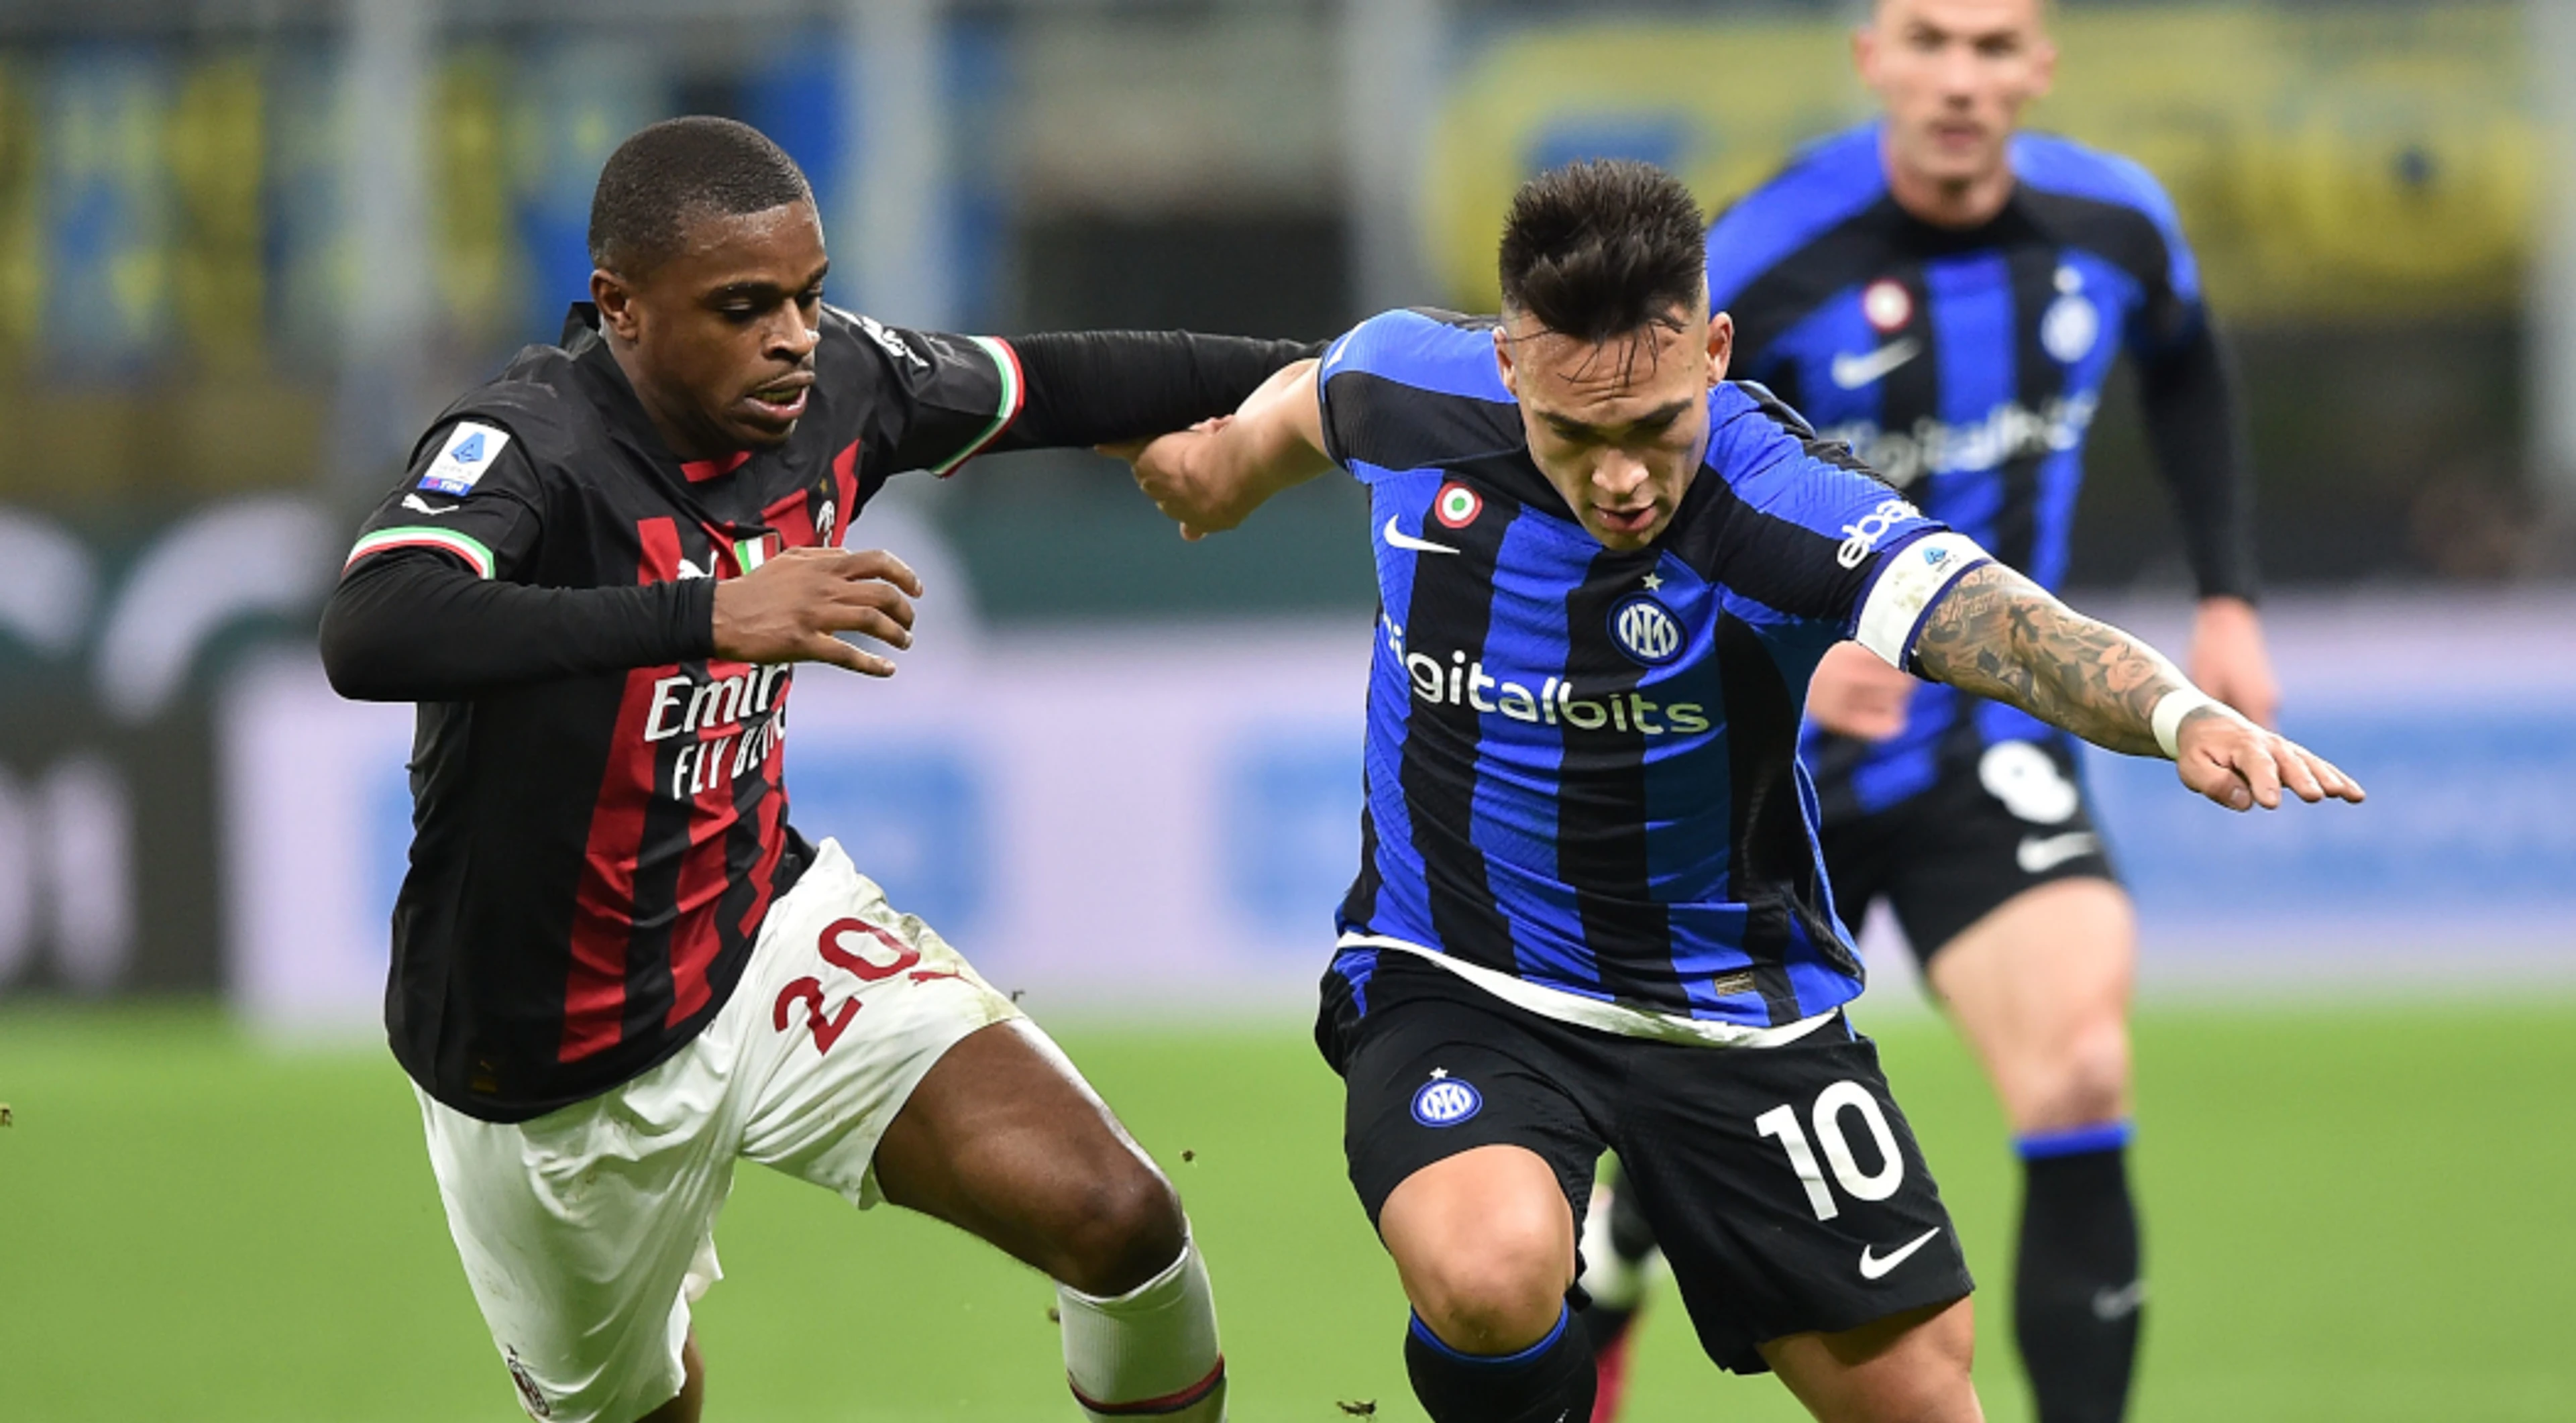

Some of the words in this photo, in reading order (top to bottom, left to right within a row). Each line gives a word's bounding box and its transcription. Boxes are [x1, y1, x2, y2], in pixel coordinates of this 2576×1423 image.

[644, 663, 789, 742] Emir
[673, 736, 731, 800] FLY
[773, 917, 920, 1056] 20
[1755, 1080, 1904, 1221] 10
